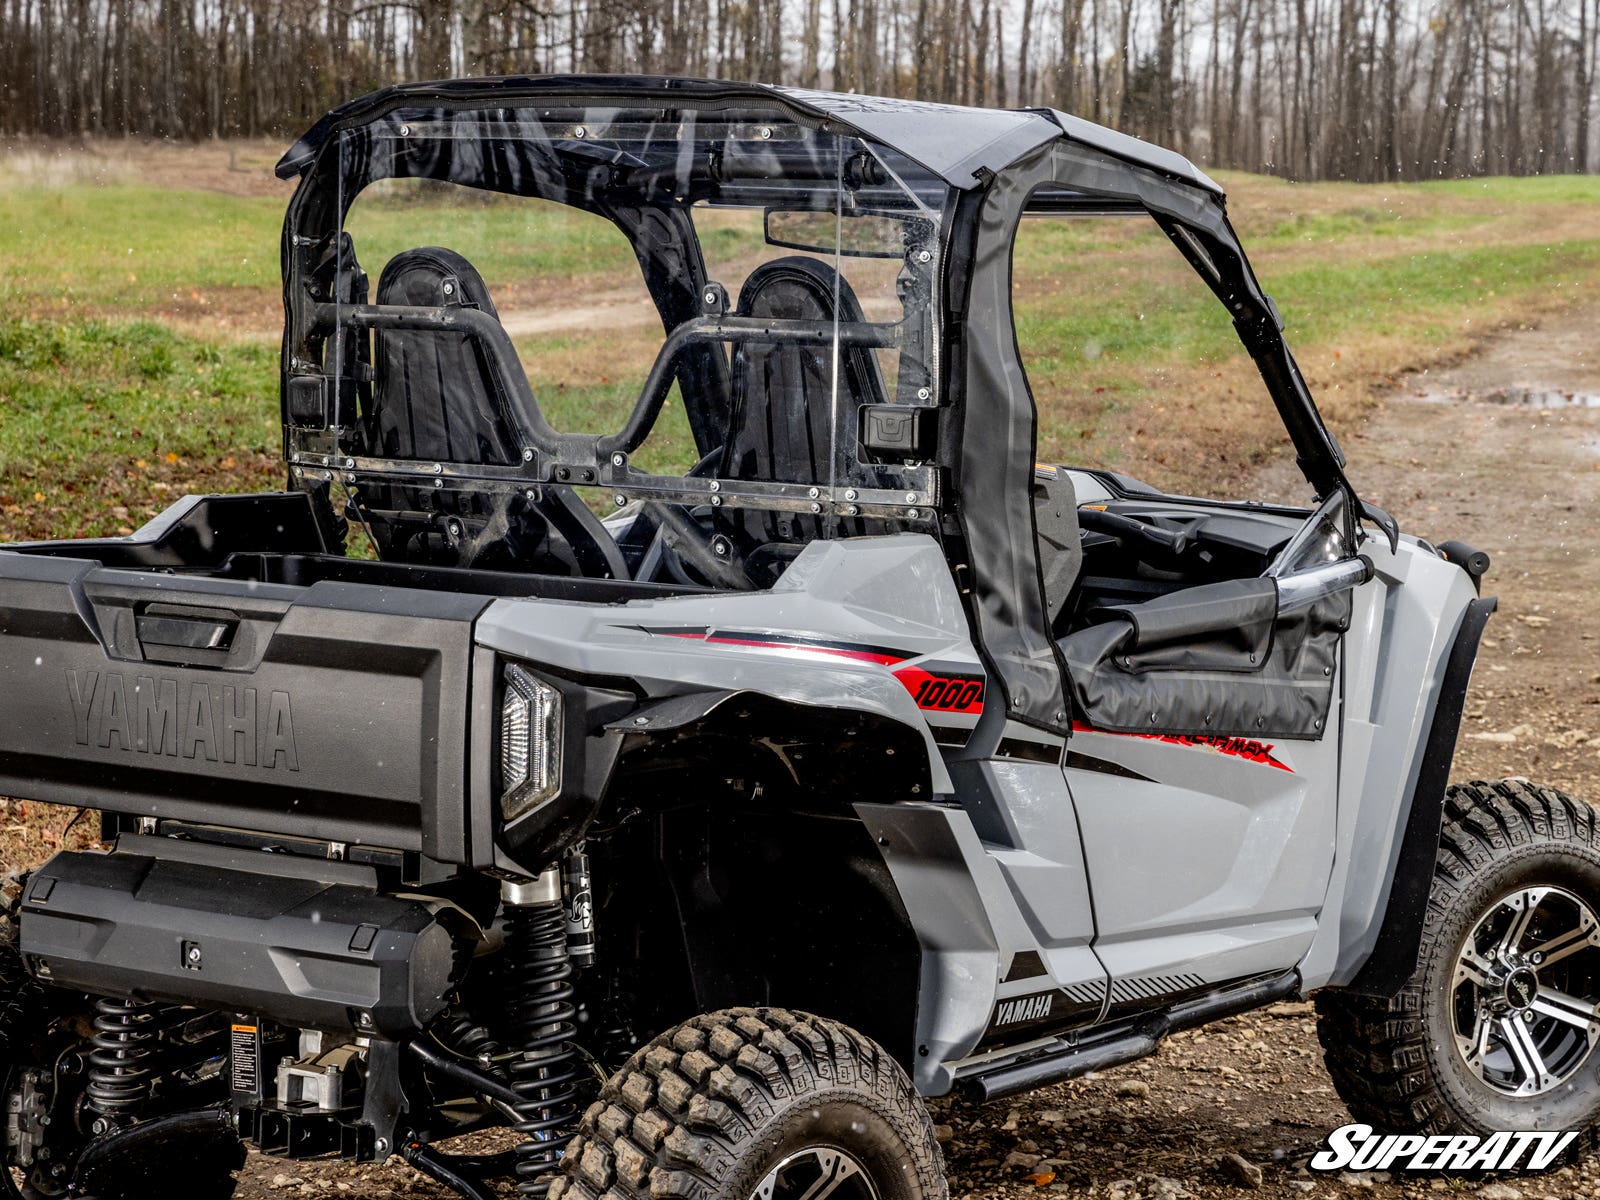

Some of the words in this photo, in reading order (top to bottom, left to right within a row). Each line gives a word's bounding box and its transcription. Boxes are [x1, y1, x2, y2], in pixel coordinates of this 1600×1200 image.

[914, 679, 981, 710] 1000
[64, 668, 300, 772] YAMAHA
[995, 994, 1053, 1026] YAMAHA
